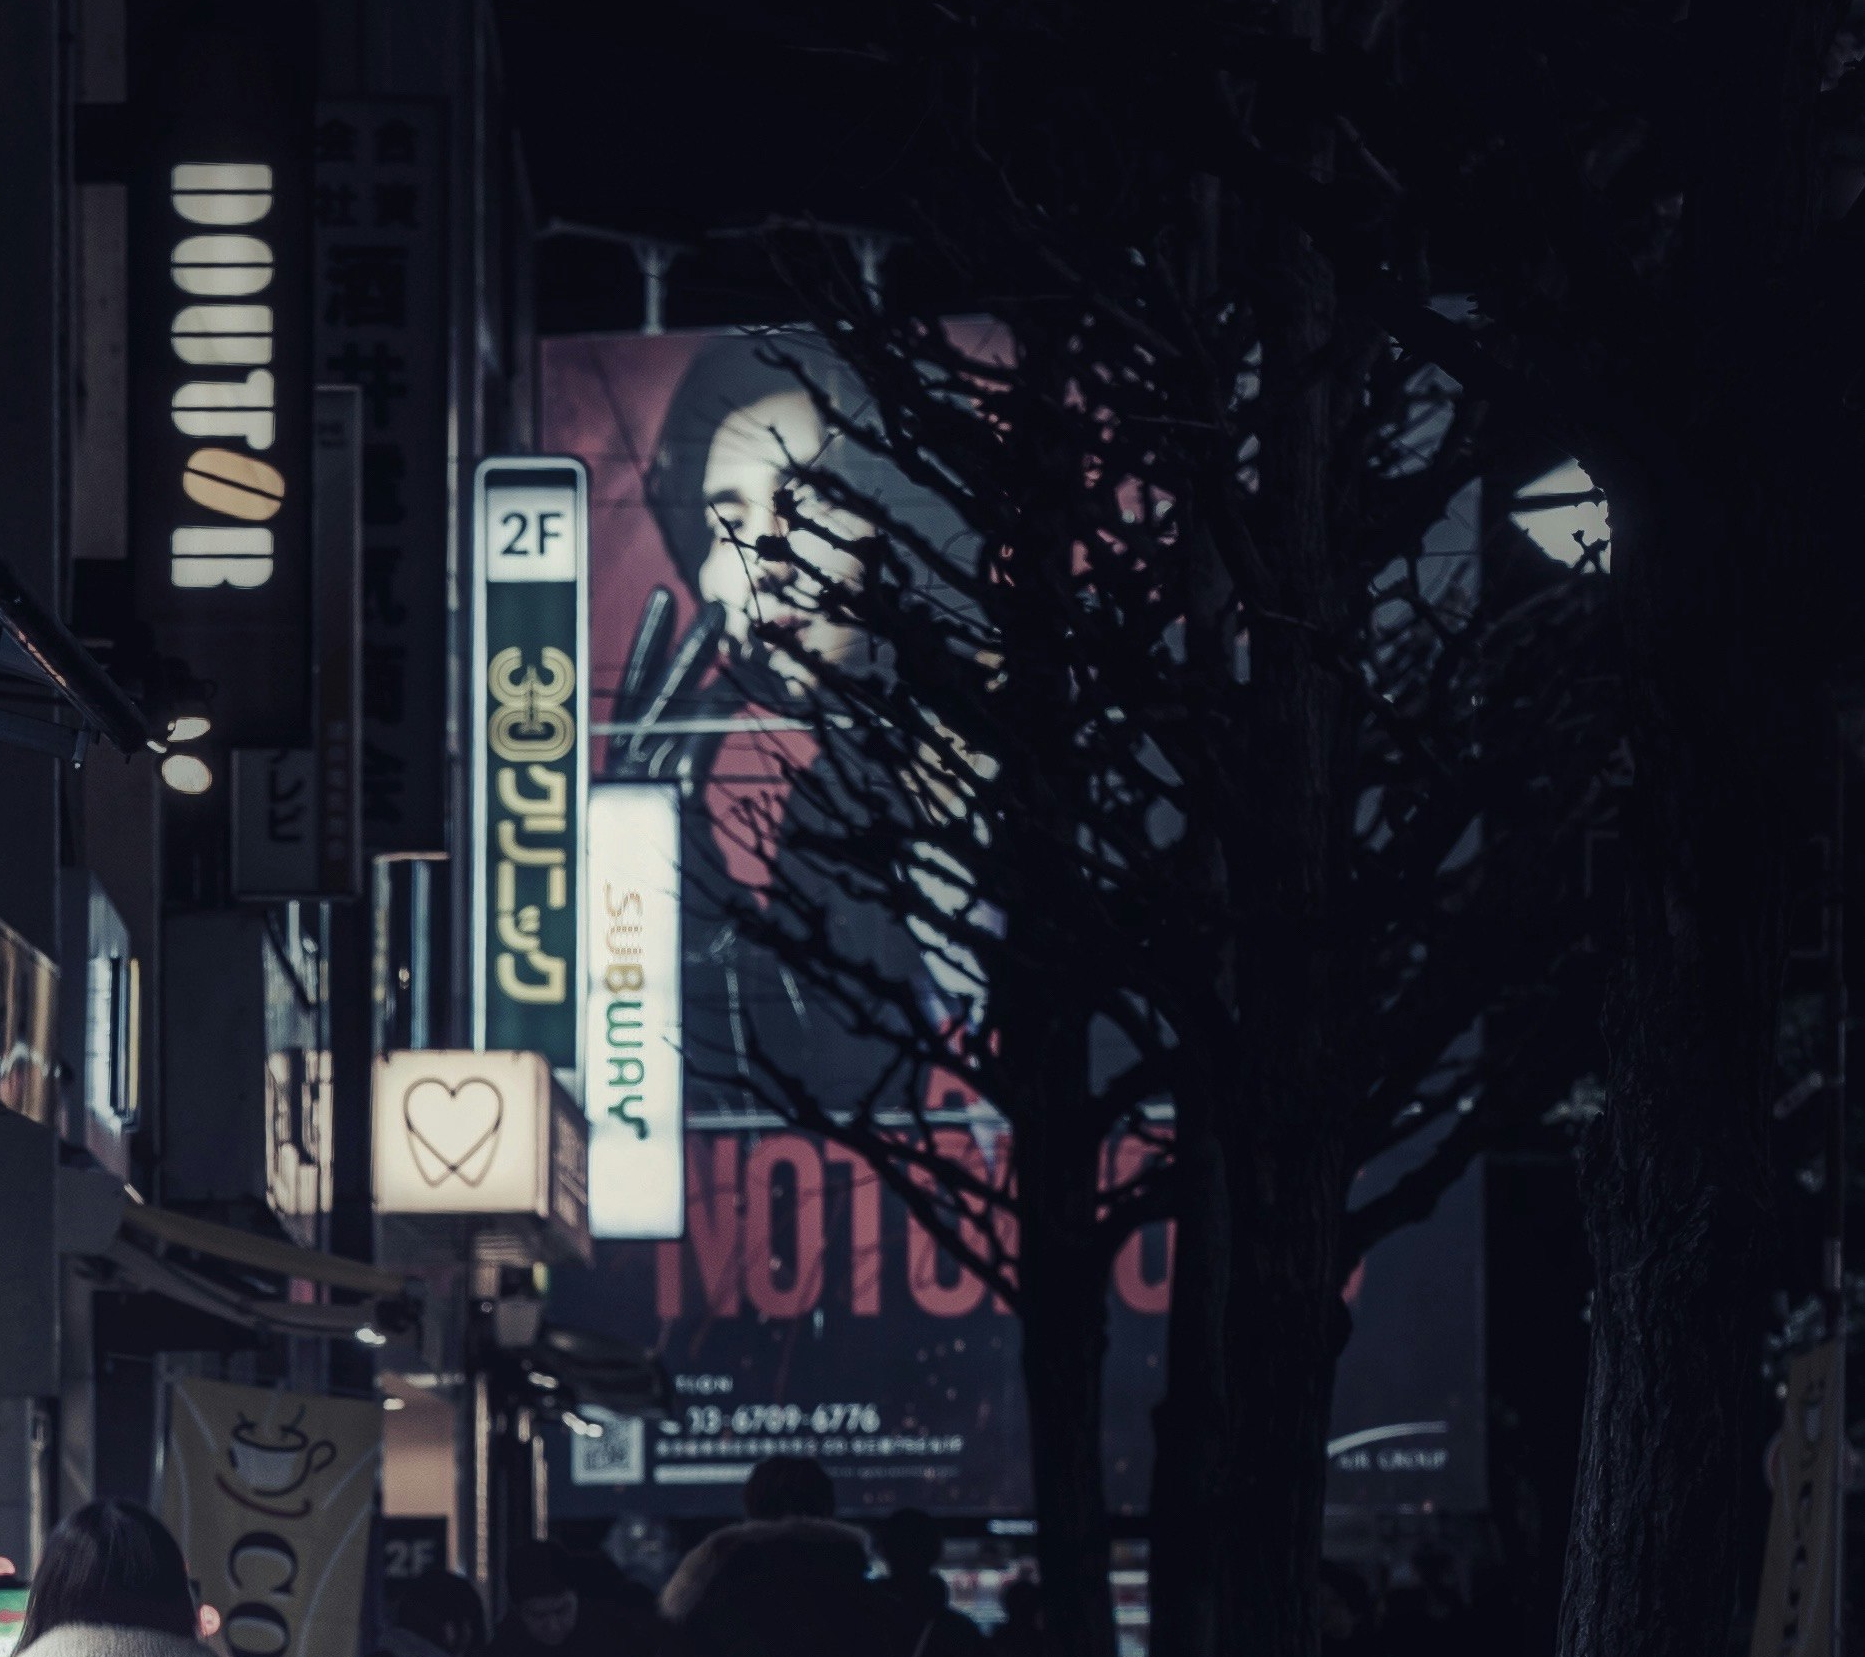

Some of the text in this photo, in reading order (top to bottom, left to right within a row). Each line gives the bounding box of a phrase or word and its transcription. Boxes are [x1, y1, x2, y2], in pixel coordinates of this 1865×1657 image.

[170, 160, 286, 589] DOUTOR
[500, 510, 564, 557] 2F
[605, 881, 649, 1140] SUBWAY
